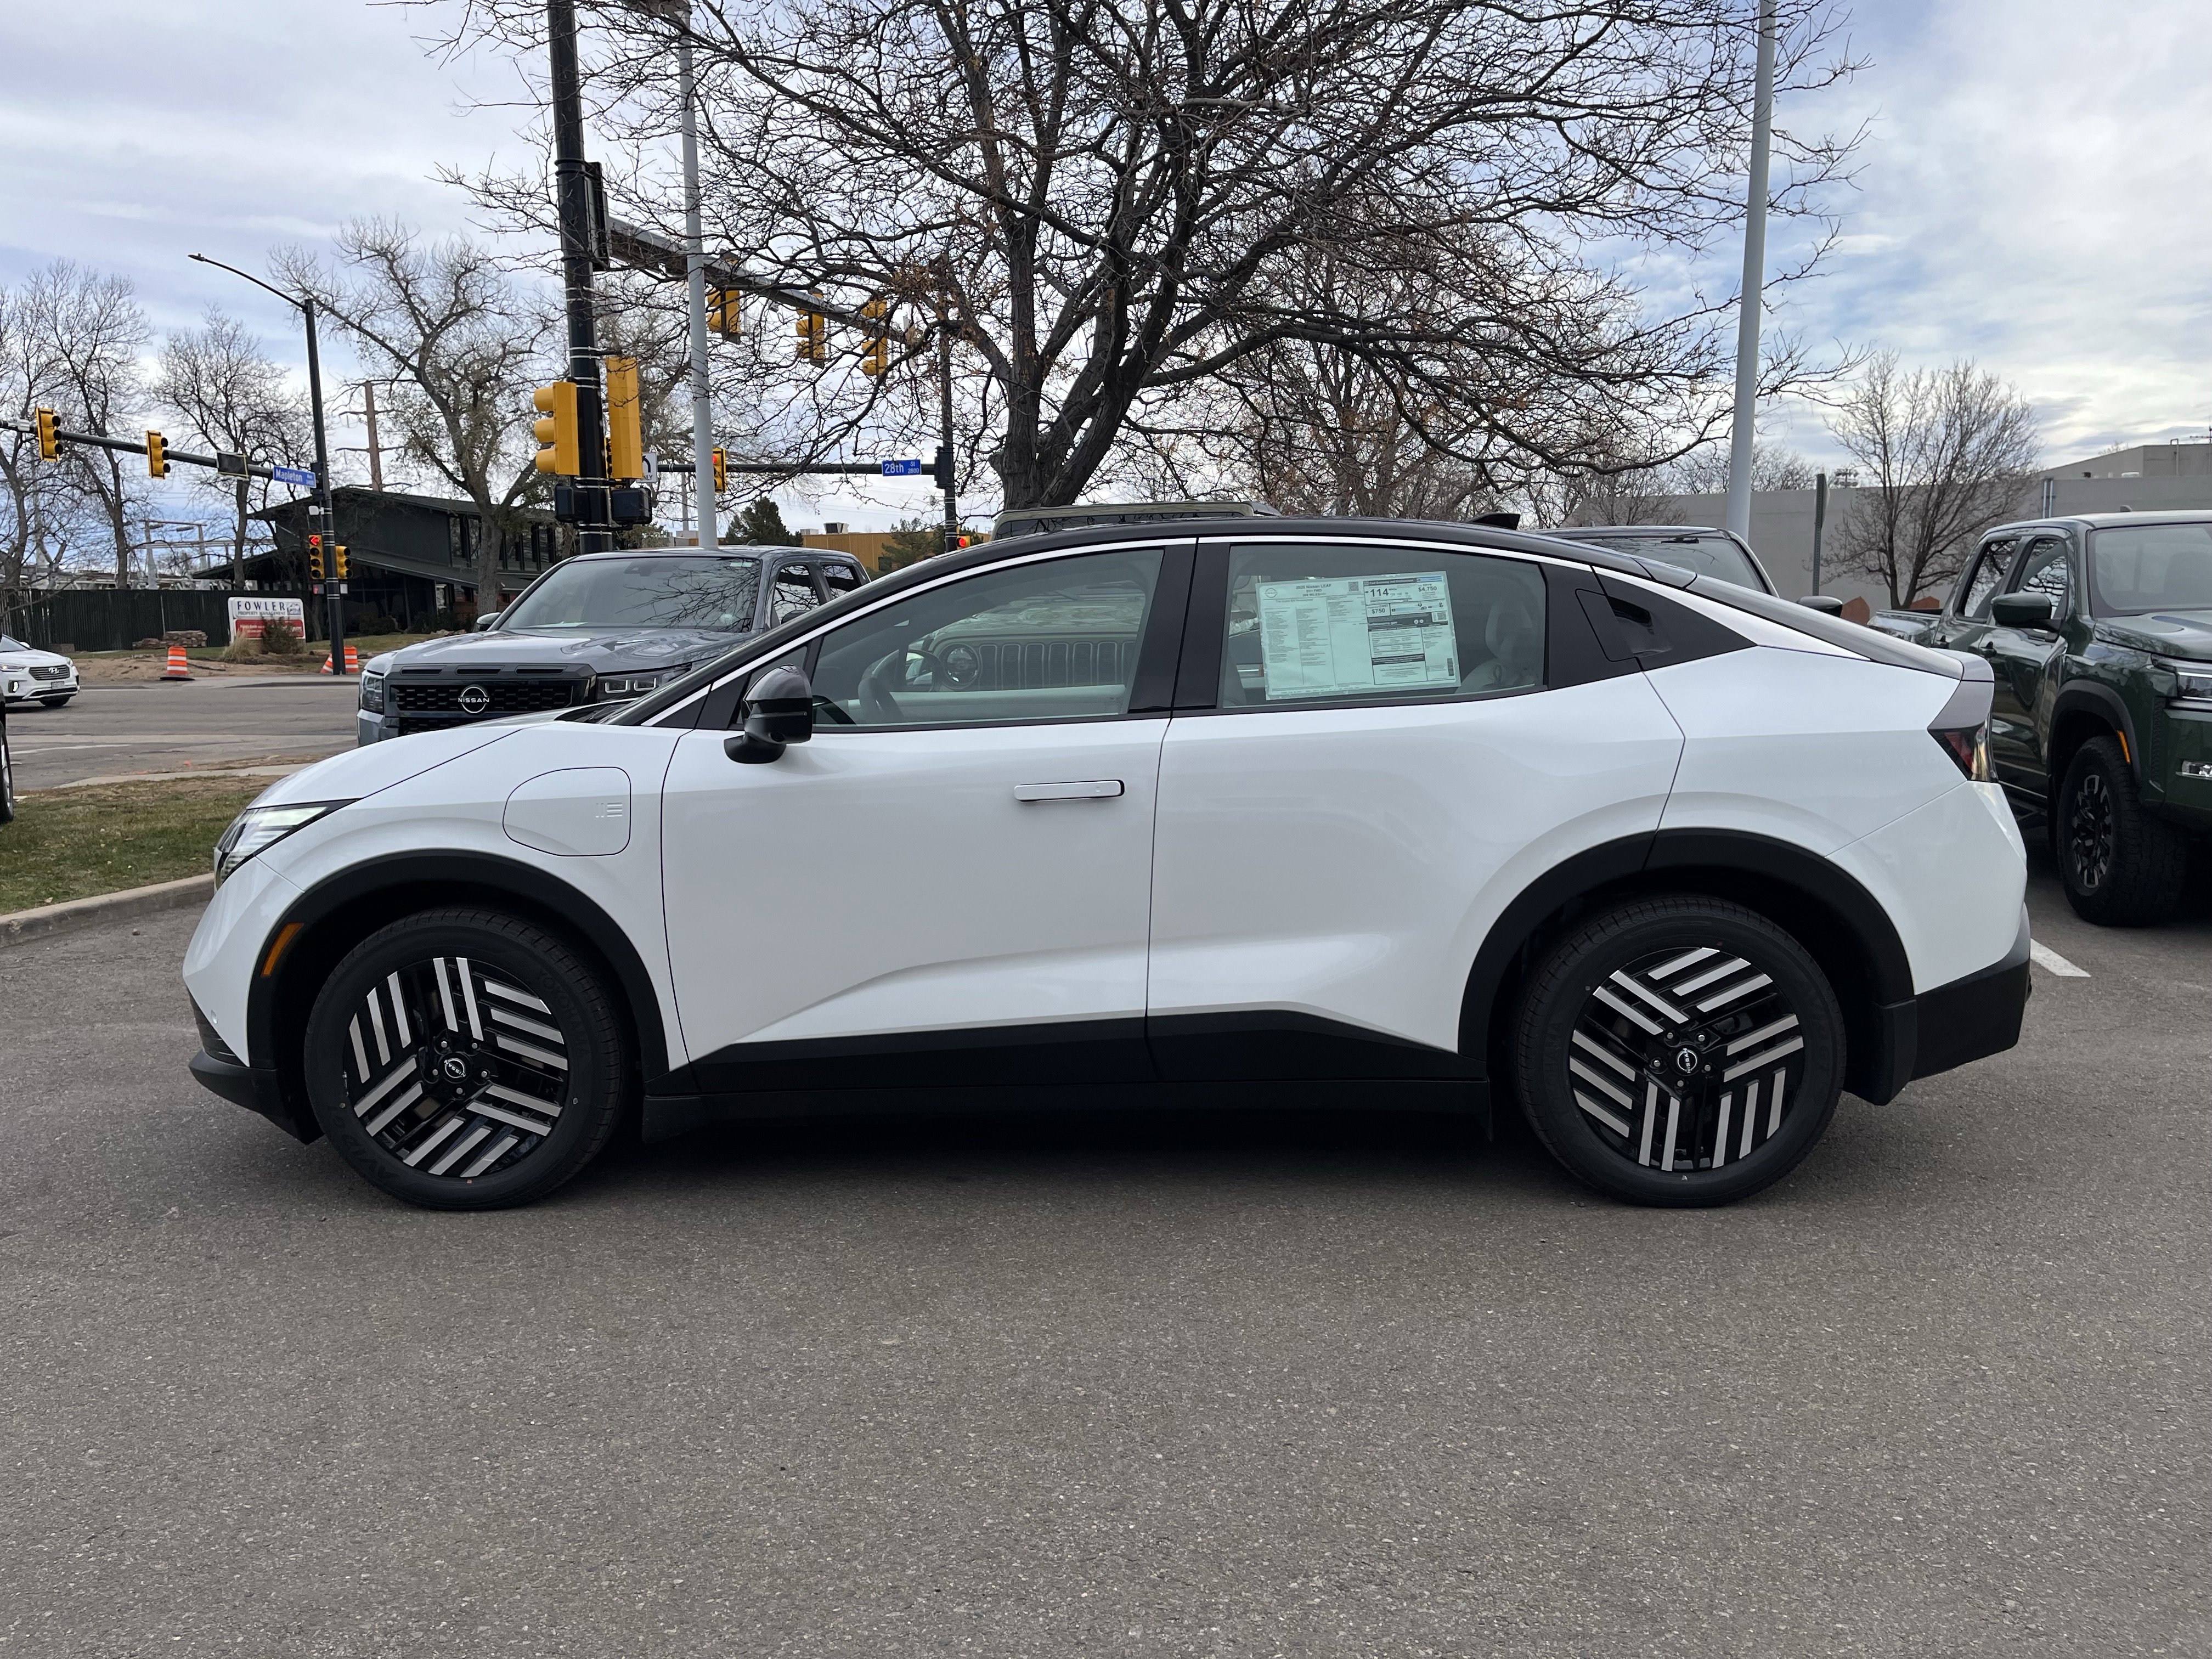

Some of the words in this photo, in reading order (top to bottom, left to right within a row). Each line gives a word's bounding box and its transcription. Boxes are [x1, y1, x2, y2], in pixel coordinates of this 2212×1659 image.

[884, 463, 904, 474] 28th
[275, 468, 303, 484] Mapleton
[1370, 588, 1389, 597] 114
[237, 601, 285, 611] FOWLER
[444, 1059, 466, 1077] NISSAN
